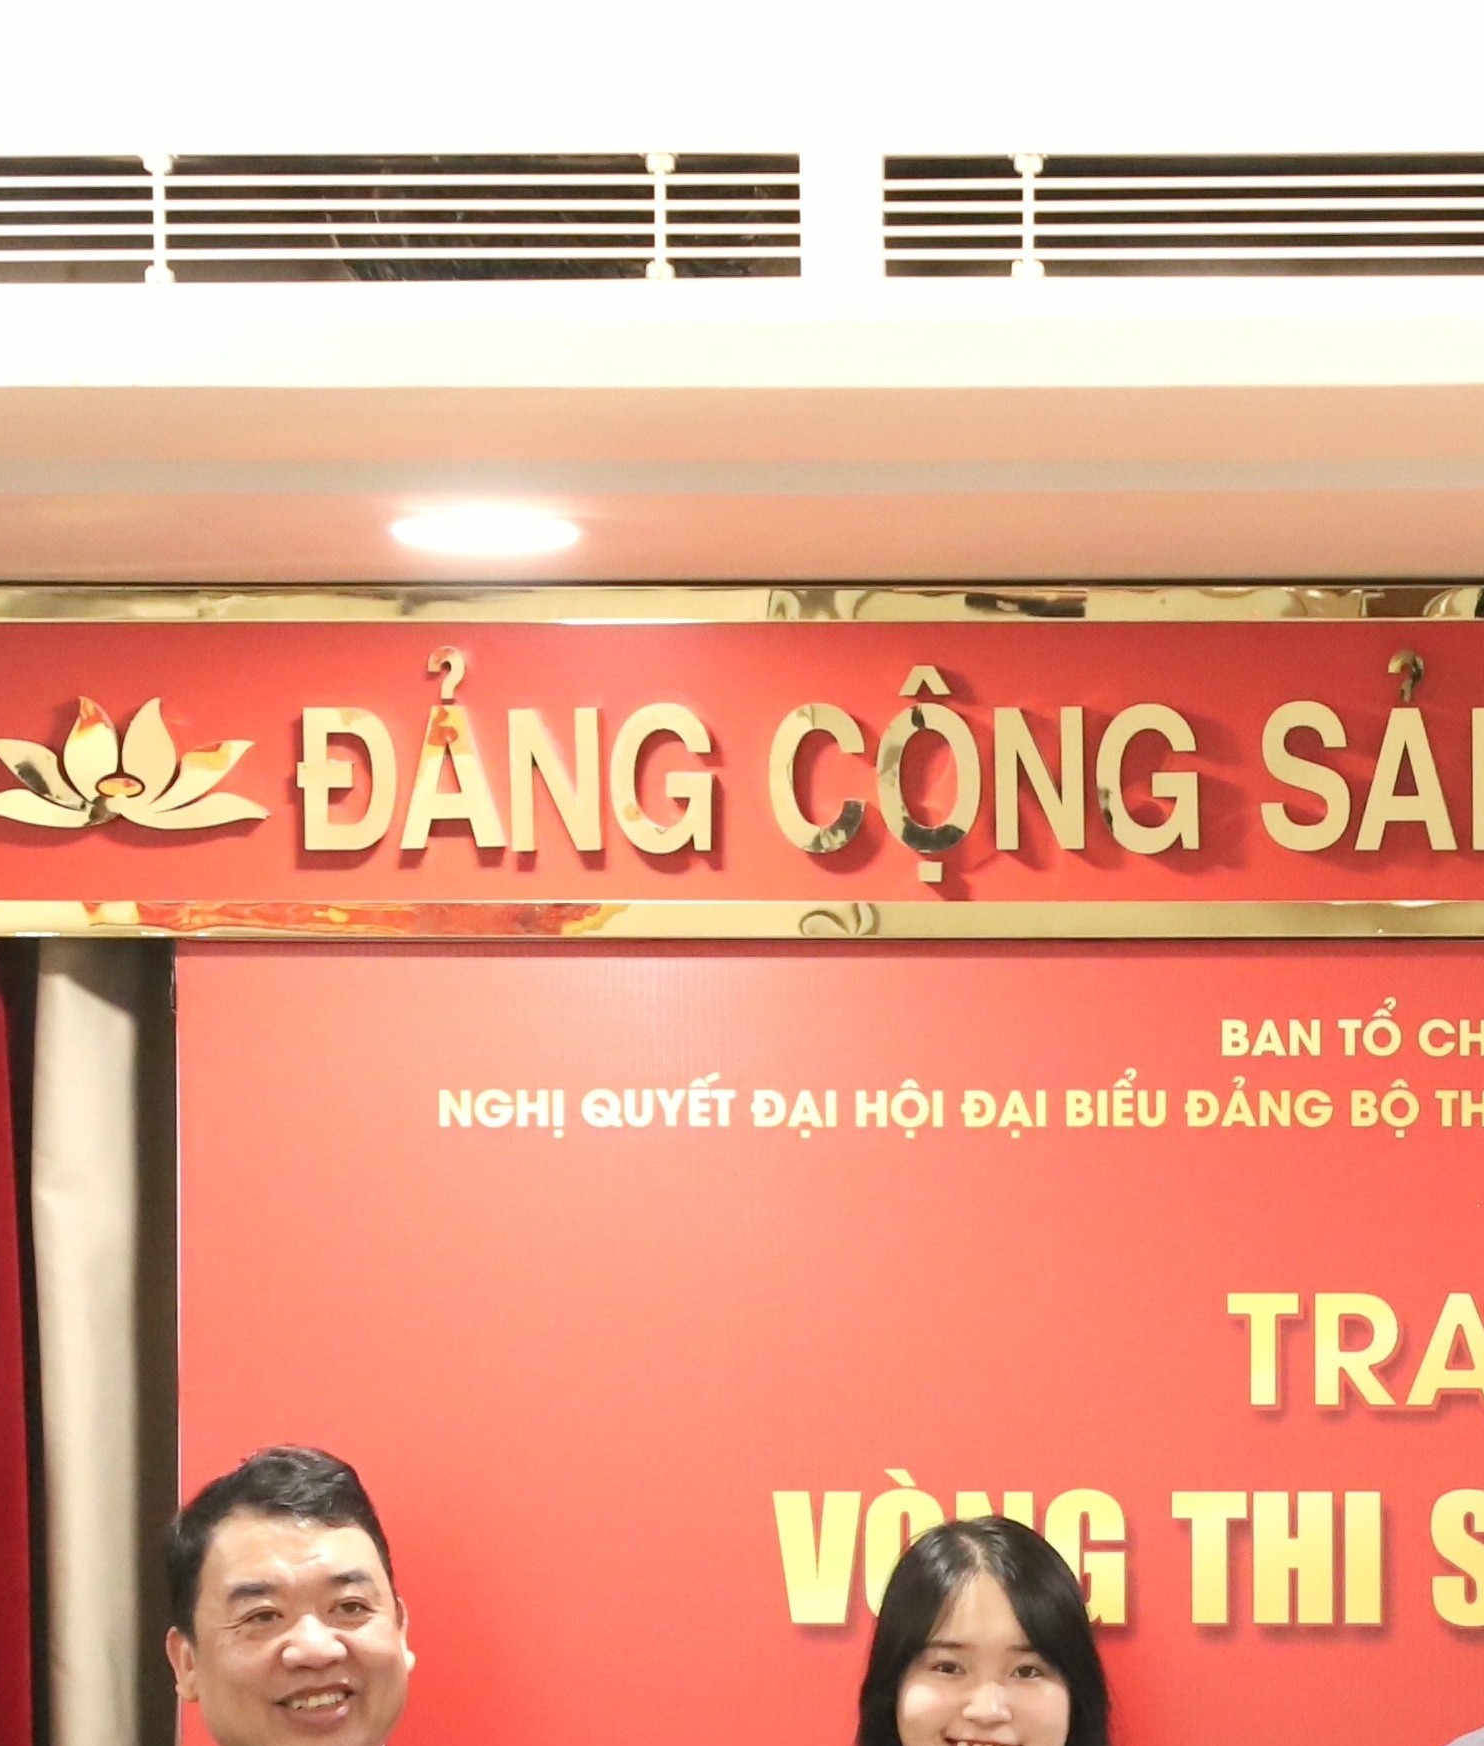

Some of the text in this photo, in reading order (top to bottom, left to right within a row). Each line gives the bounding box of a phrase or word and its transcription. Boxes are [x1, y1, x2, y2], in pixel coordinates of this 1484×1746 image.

[296, 646, 717, 854] ĐẢNG
[768, 665, 1200, 881] CỘNG
[1223, 1022, 1322, 1058] BAN
[1343, 999, 1403, 1058] TỔ
[438, 1089, 564, 1139] NGHỊ
[581, 1072, 736, 1127] QUYẾT
[751, 1089, 837, 1138] ĐẠI
[855, 1079, 944, 1139] HỘI
[961, 1089, 1048, 1139] ĐẠI
[1066, 1070, 1167, 1129] BIỂU
[1185, 1078, 1334, 1128] ĐẢNG
[1352, 1080, 1420, 1139] BỘ
[772, 1468, 1127, 1626] VÒG
[1172, 1491, 1382, 1627] THI
